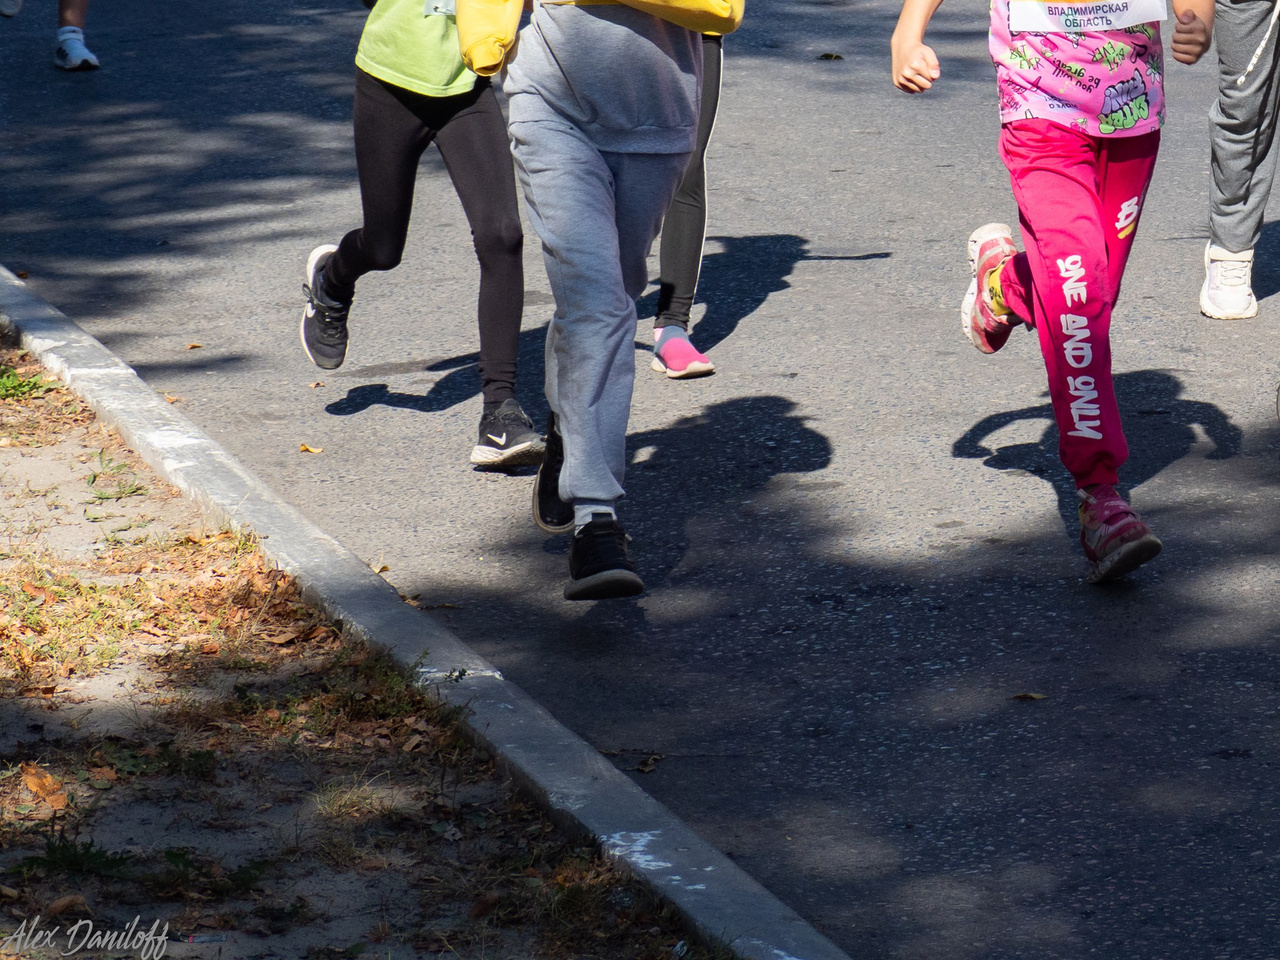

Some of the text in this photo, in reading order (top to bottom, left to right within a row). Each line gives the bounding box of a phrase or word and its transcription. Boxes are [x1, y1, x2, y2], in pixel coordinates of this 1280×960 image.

[1047, 2, 1129, 17] ВЛАДИМИРСКАЯ
[1064, 16, 1113, 28] ОБЛАСТЬ
[1052, 67, 1095, 93] you will
[1088, 75, 1101, 89] be
[1101, 68, 1146, 115] FUN!
[1057, 254, 1104, 441] ONE AND ONLY
